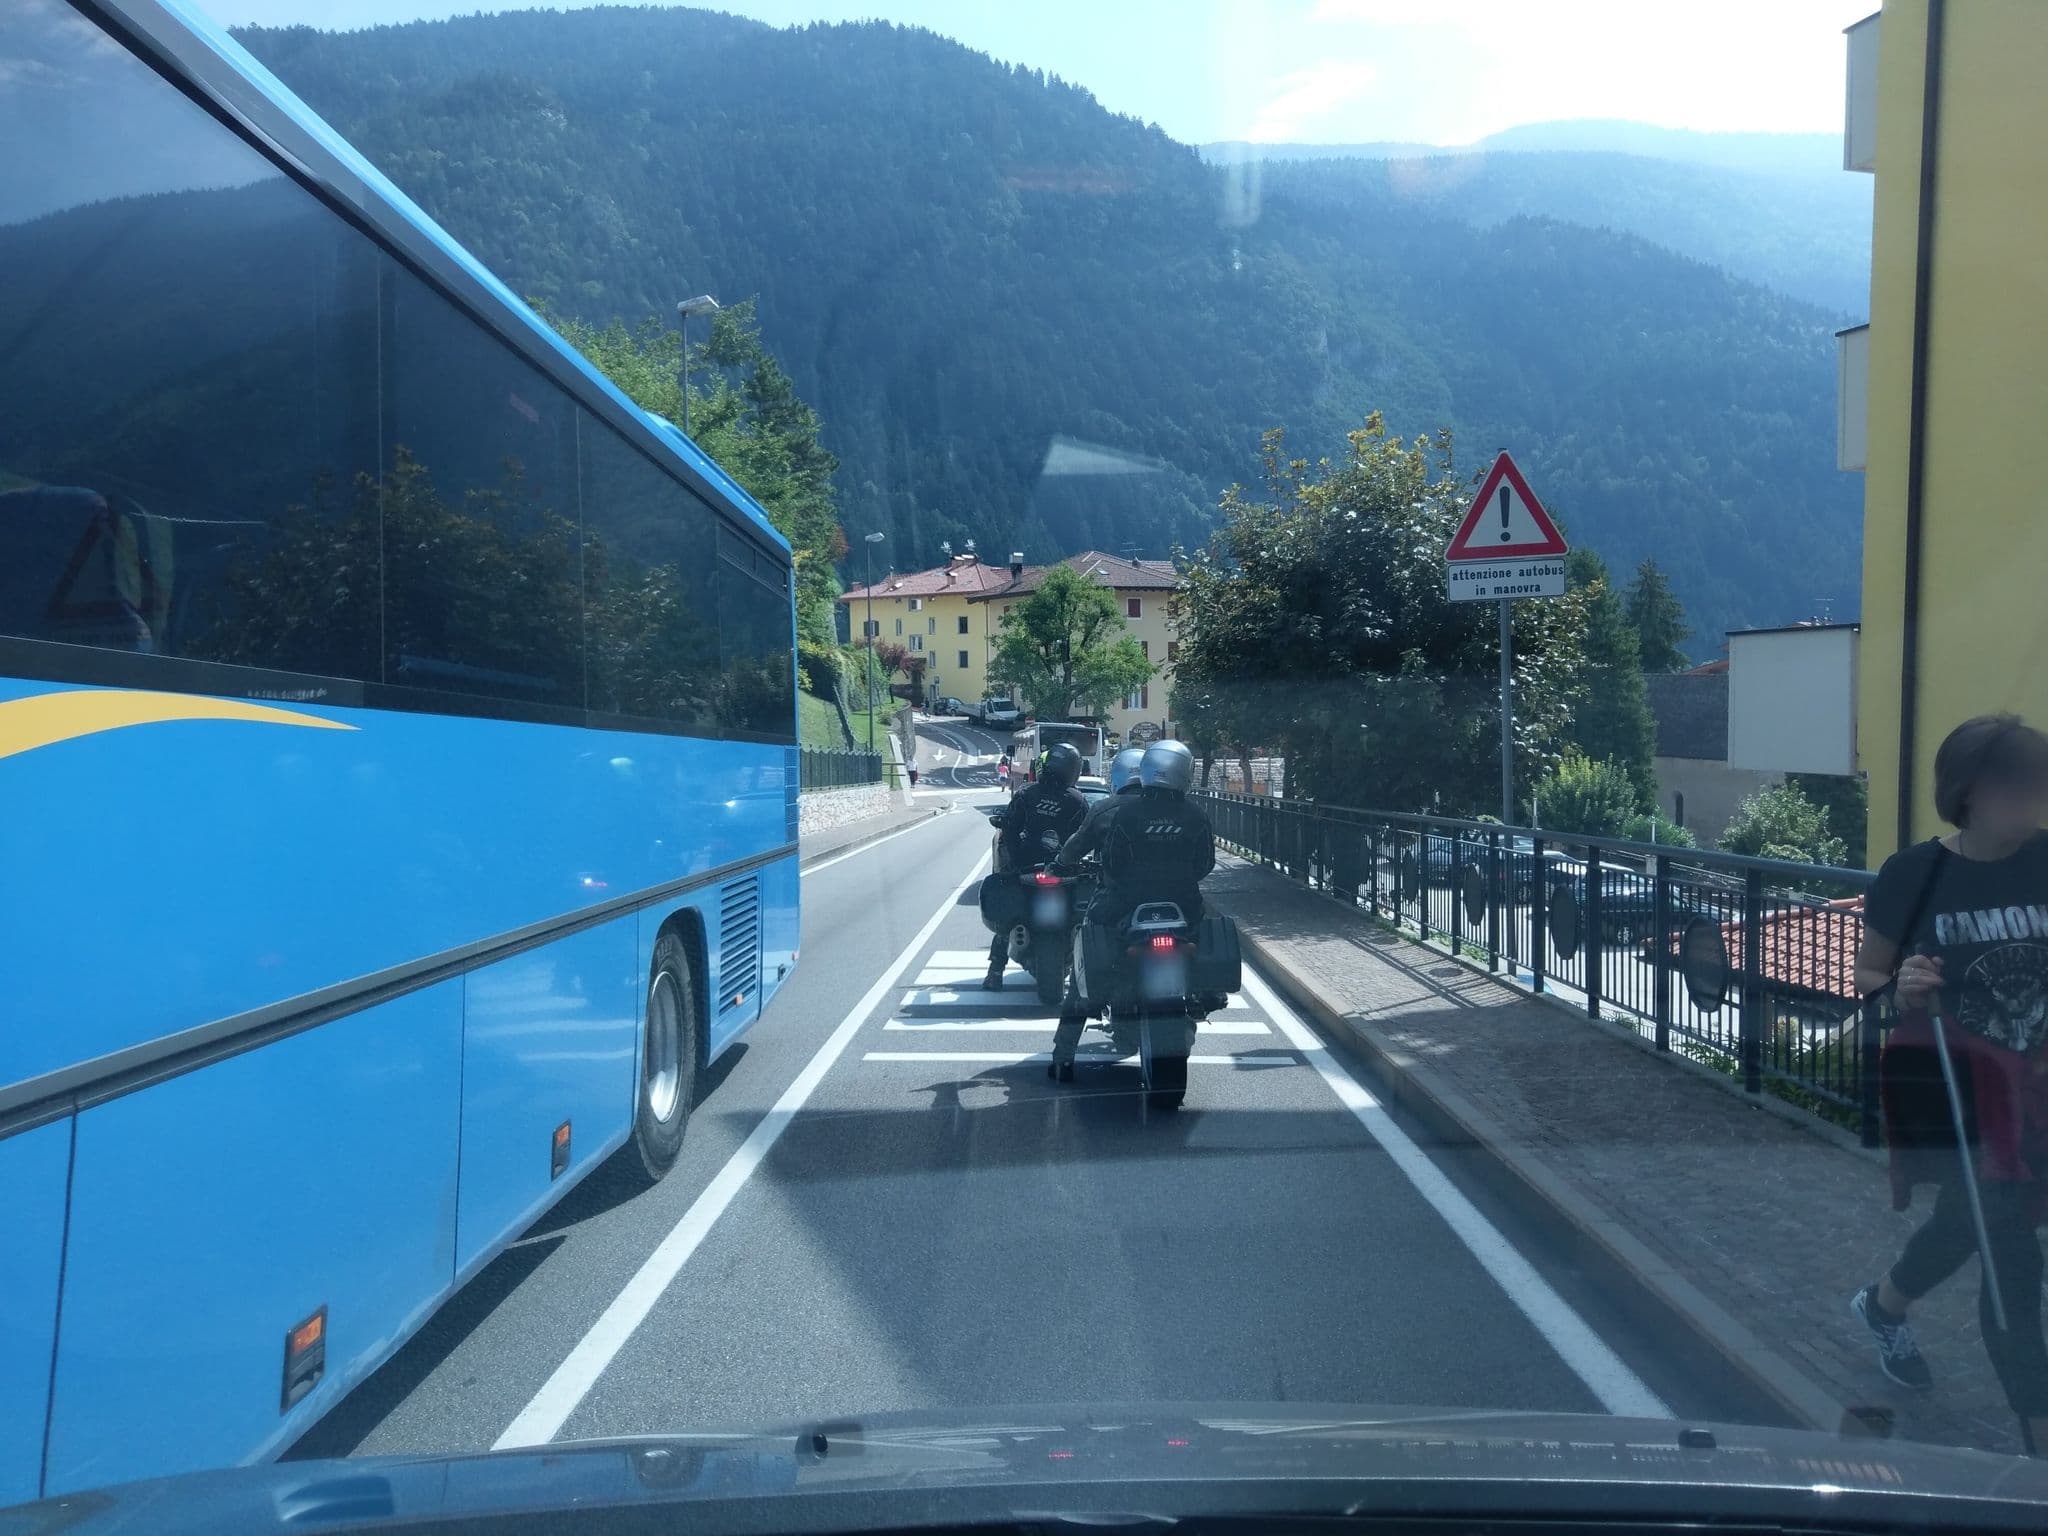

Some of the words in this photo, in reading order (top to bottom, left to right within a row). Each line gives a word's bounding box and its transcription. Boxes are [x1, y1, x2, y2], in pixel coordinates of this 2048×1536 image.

[1452, 567, 1512, 581] attenzione
[1518, 564, 1564, 577] autobus
[1475, 584, 1486, 596] in
[1493, 583, 1541, 596] manovra
